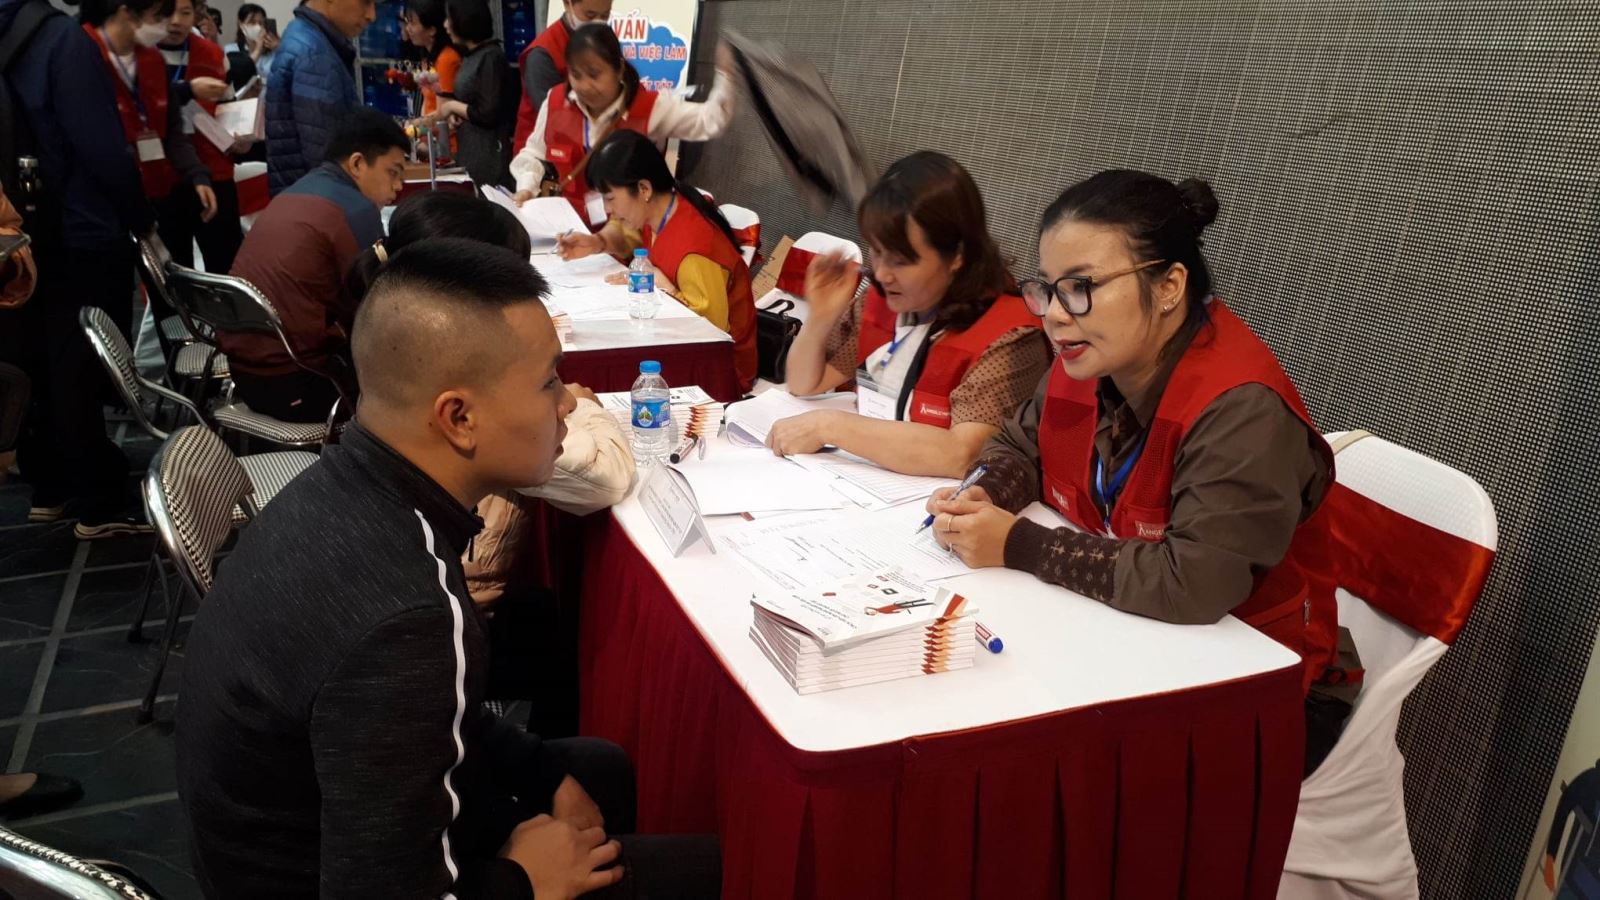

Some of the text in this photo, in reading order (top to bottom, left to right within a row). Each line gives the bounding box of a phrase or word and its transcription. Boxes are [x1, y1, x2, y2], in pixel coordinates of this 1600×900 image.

[613, 11, 646, 39] VẤN
[624, 43, 686, 62] VÀ VIỆC LÀM
